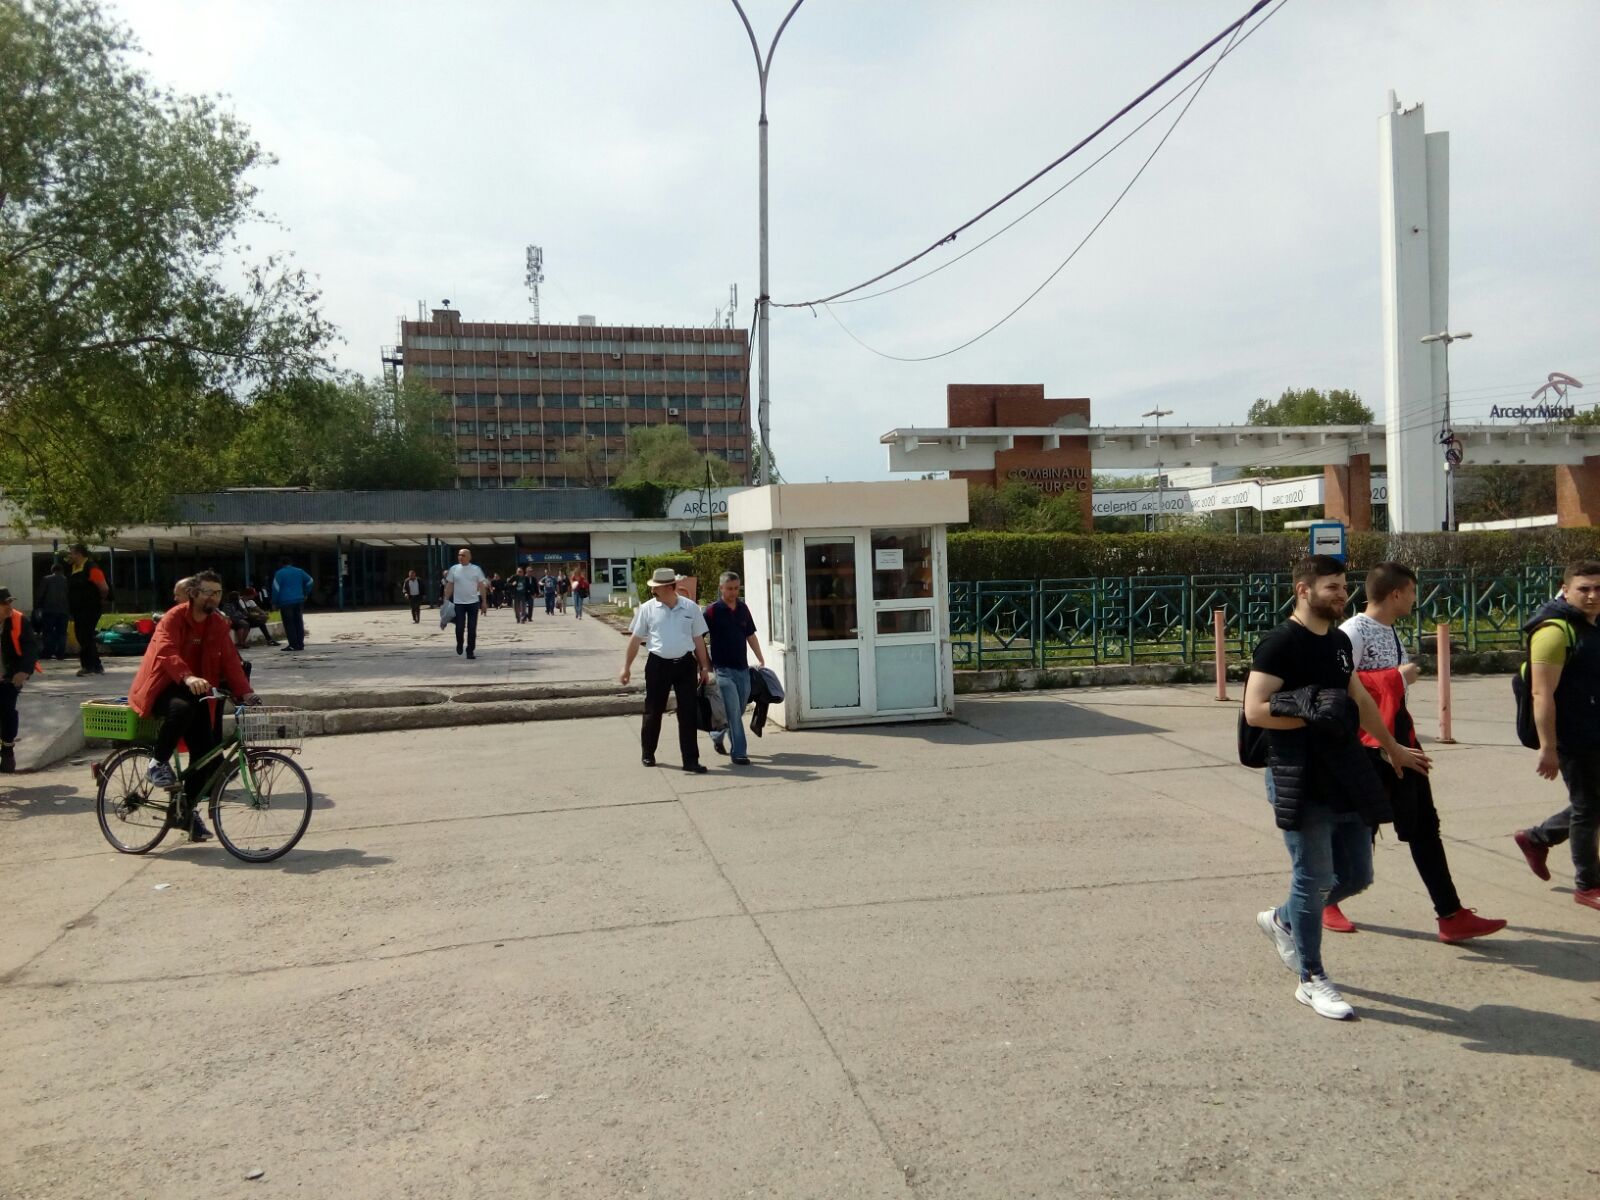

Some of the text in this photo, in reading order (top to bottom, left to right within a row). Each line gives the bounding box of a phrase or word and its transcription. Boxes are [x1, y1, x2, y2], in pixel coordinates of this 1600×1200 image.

[1490, 404, 1575, 418] ArcelorMittal
[1007, 467, 1088, 480] COMBINATUL
[684, 502, 708, 513] ARC
